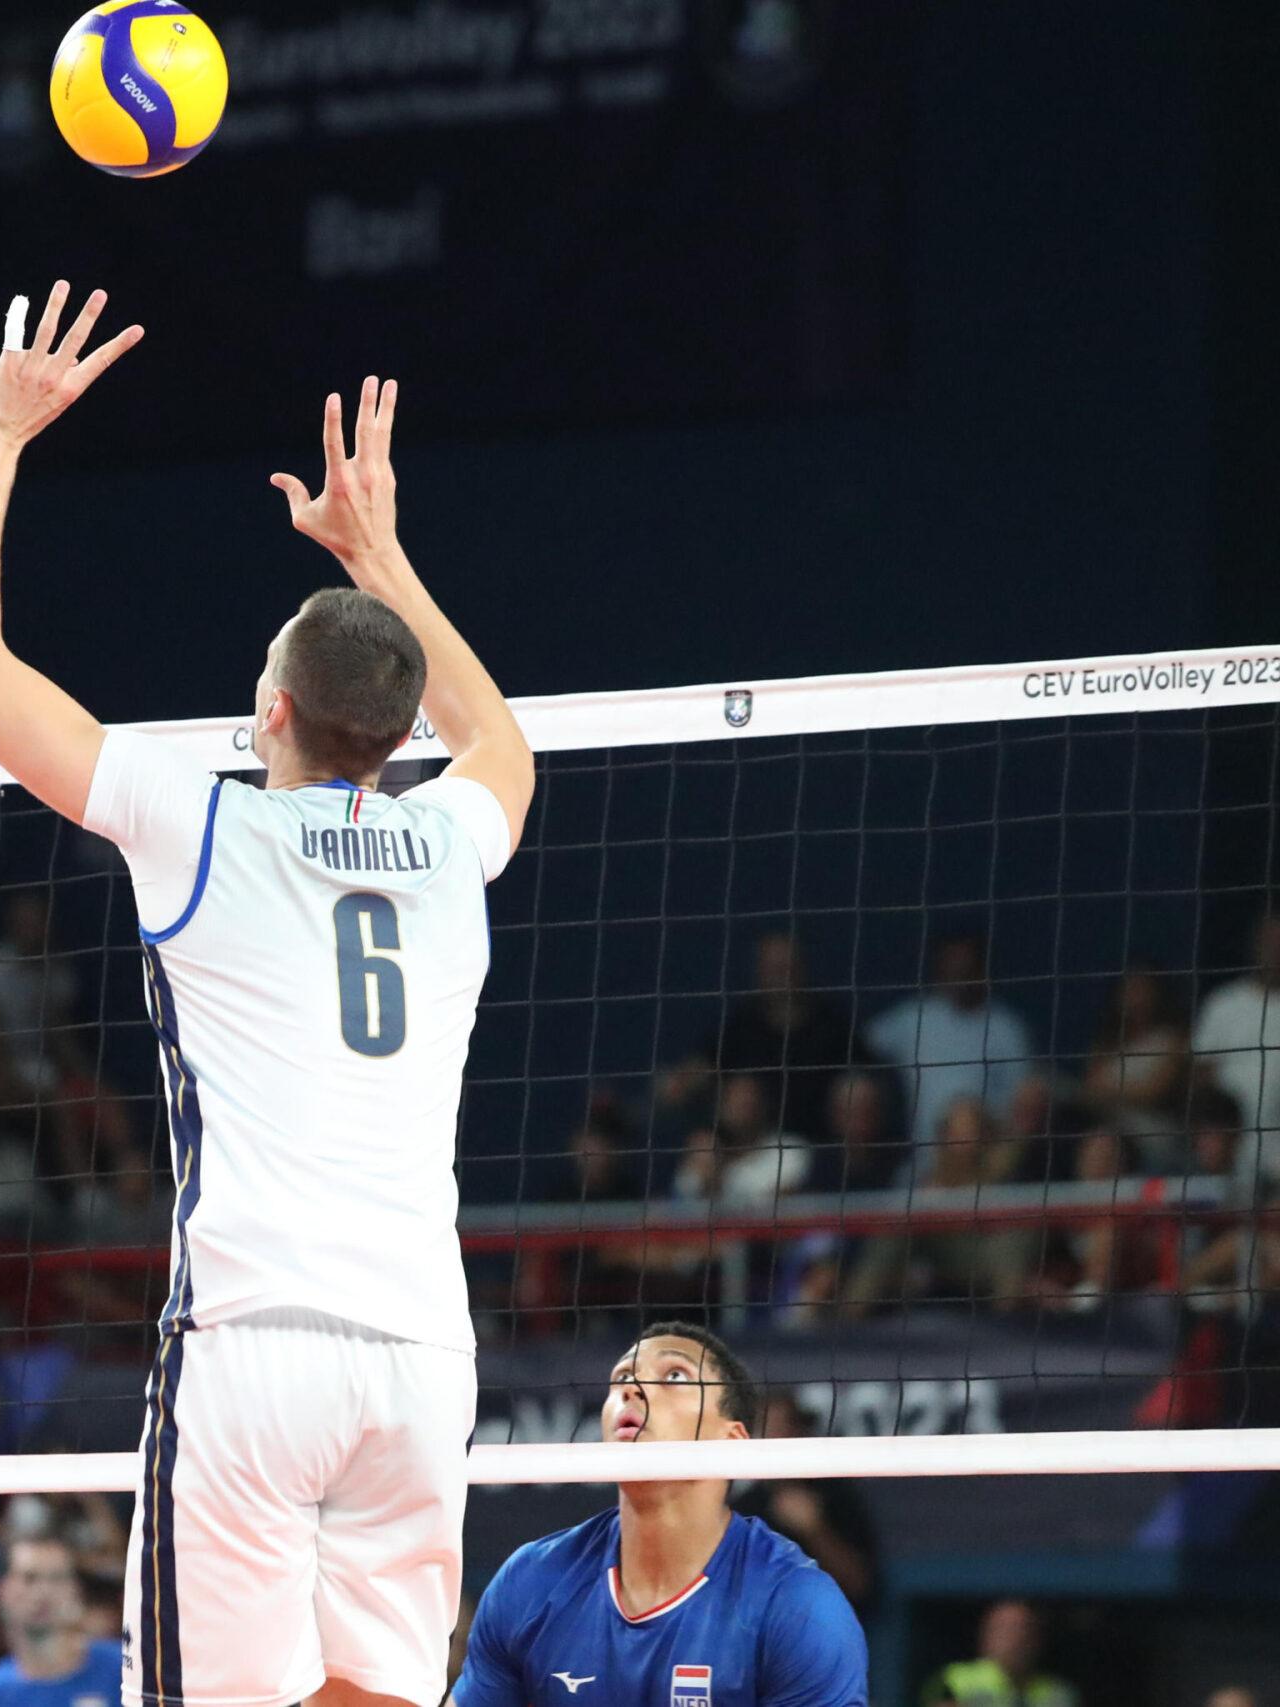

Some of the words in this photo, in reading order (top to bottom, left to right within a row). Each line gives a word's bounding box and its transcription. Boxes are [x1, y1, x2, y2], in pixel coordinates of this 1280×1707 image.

[120, 73, 157, 112] V200W
[1023, 671, 1075, 698] CEV
[1082, 662, 1215, 694] EuroVolley
[1223, 658, 1280, 686] 2023
[332, 891, 407, 1058] 6
